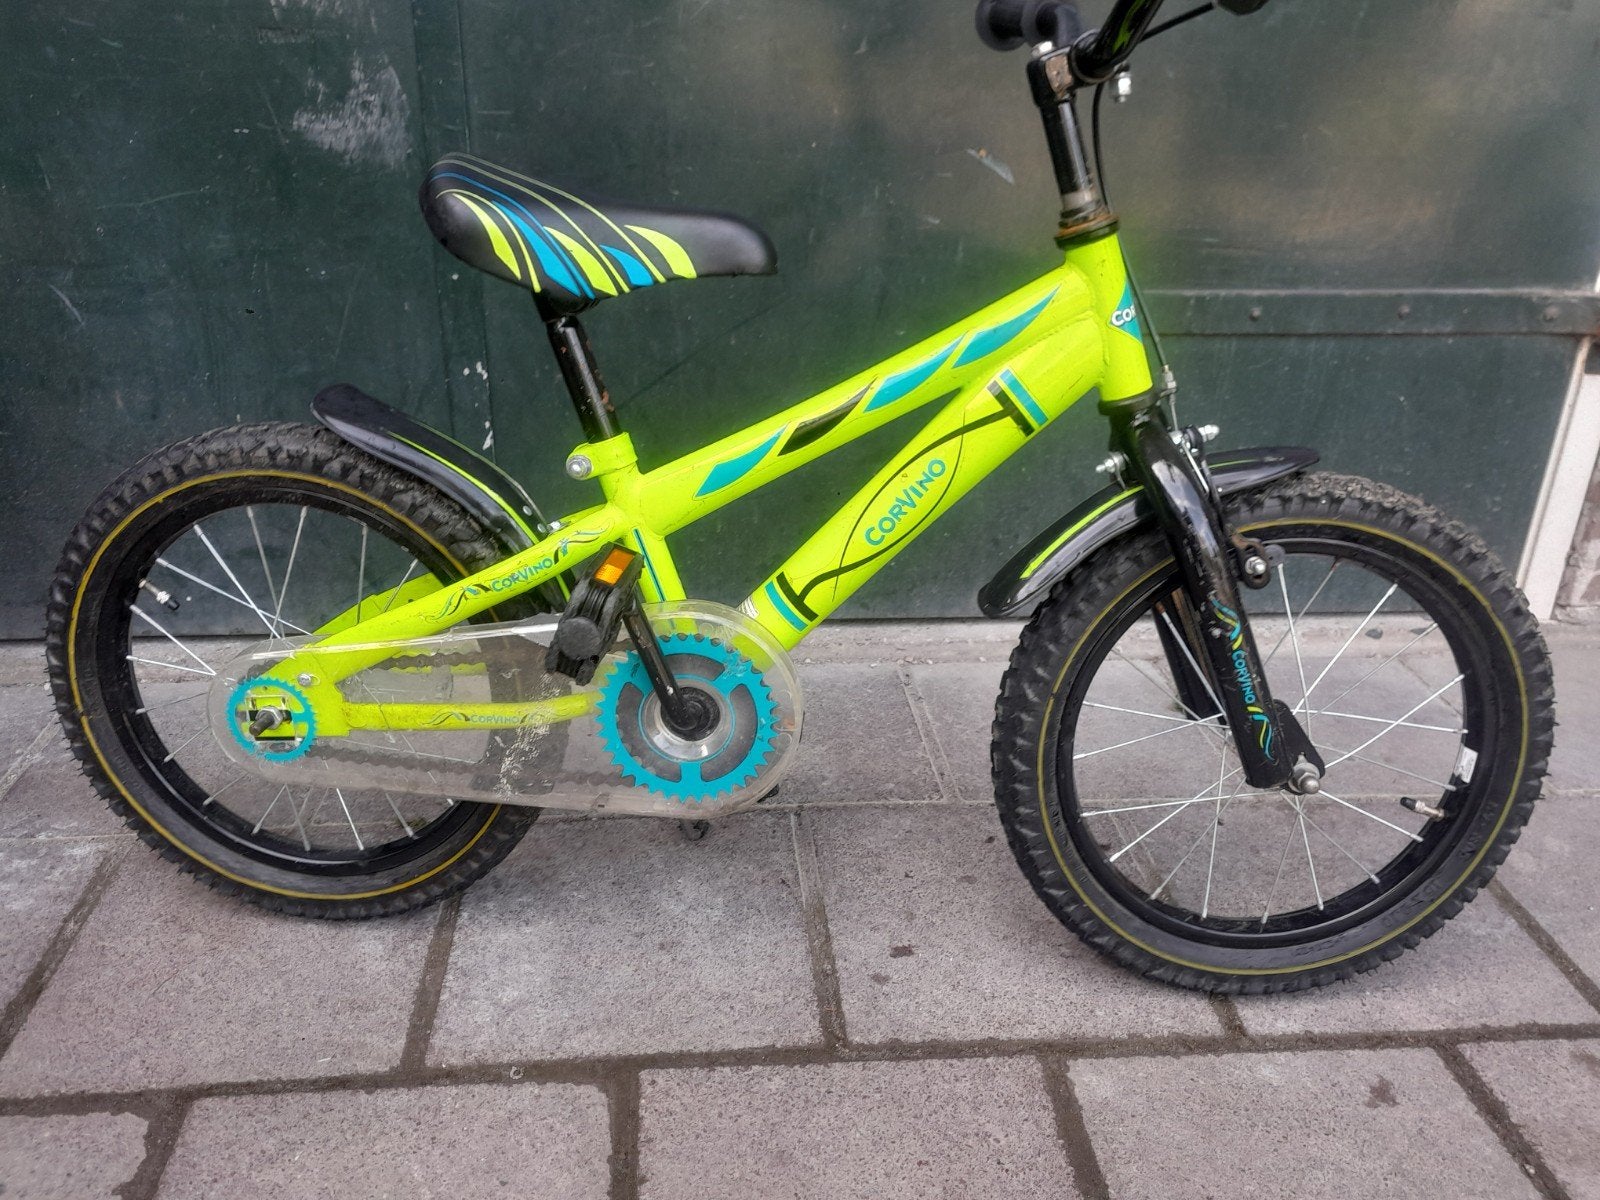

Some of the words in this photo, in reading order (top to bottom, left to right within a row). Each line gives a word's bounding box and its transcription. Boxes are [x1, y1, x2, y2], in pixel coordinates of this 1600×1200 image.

[864, 458, 946, 546] CORVINO
[490, 556, 554, 592] CORVINO
[1231, 649, 1256, 704] CORVINO
